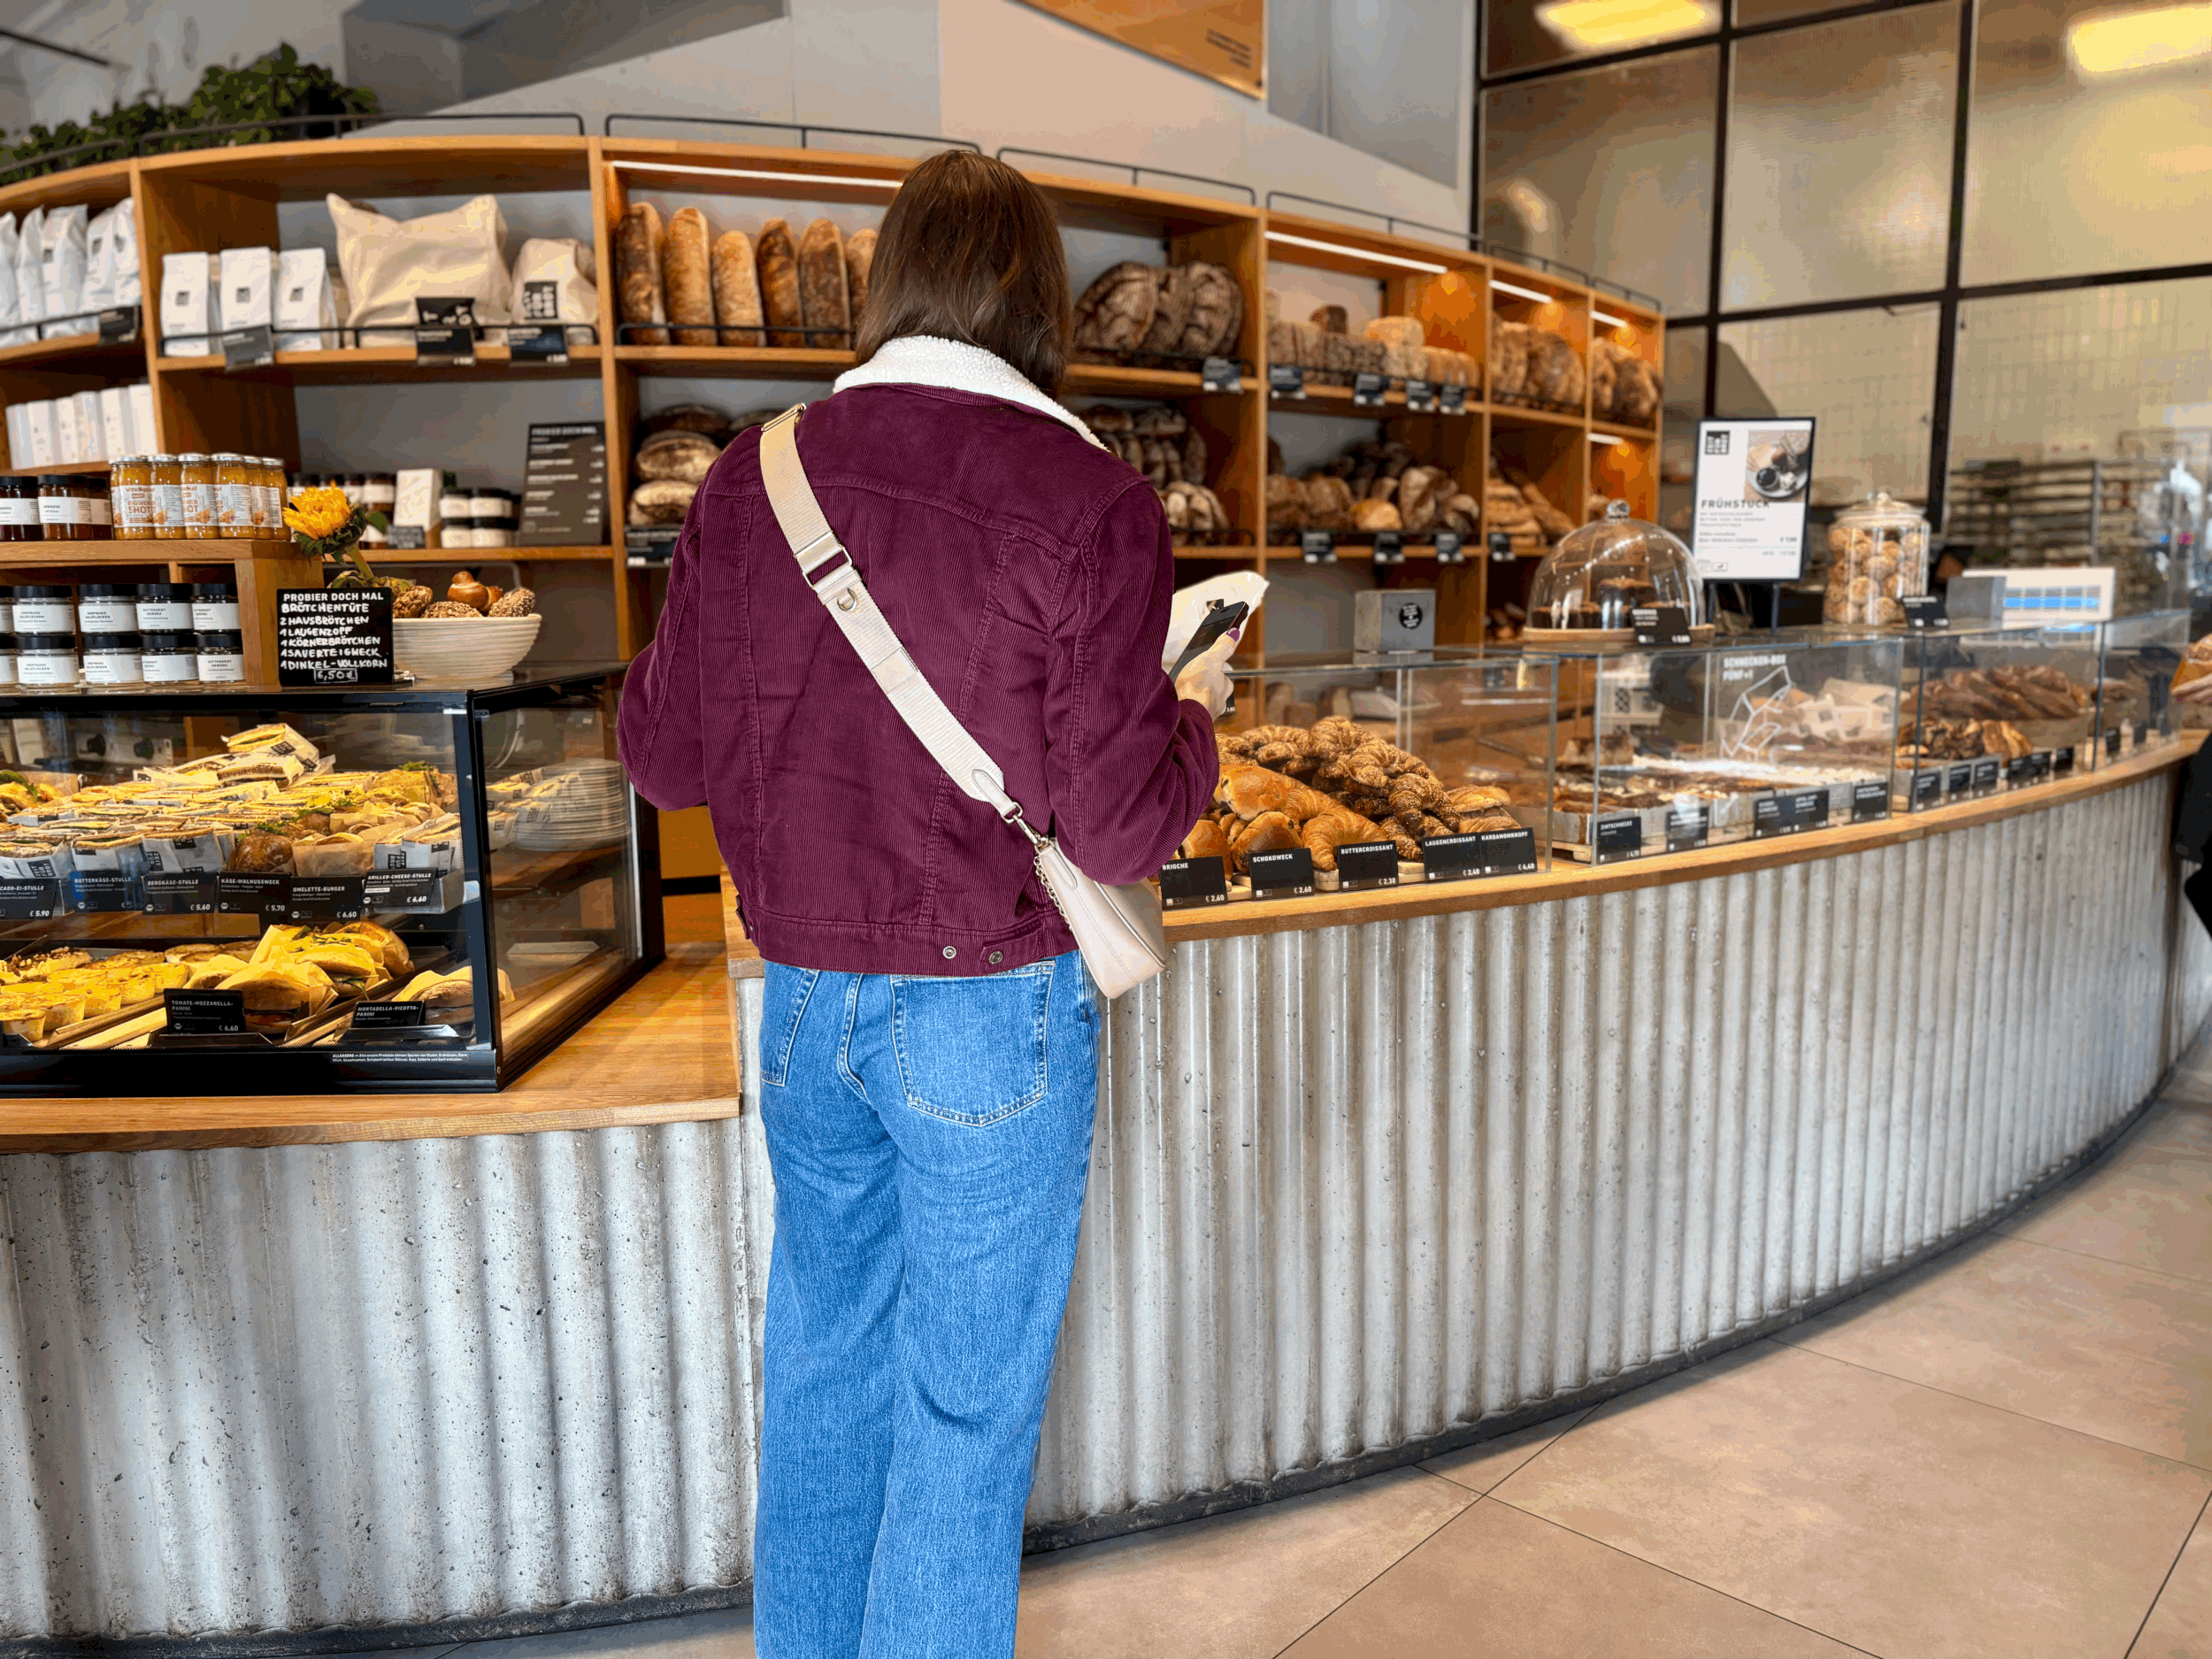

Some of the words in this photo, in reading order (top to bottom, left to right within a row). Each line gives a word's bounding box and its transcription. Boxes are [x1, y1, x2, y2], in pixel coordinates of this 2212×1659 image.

[331, 592, 358, 601] DOCH
[281, 602, 369, 613] BRÖTCHENTÜTE
[280, 617, 287, 626] 2
[288, 615, 369, 626] HAUSBRÖTCHEN
[288, 626, 353, 637] LAUGENZOPF
[288, 635, 380, 647] KÖRNERBRÖTCHEN
[280, 649, 287, 657] 1
[1600, 820, 1632, 831] ZIMTSCHNECKE
[1425, 835, 1476, 847] LAUGENCROISSANT
[1340, 844, 1394, 855] BUTTERCROISSANT
[1252, 853, 1294, 863] SCHOKOWECK
